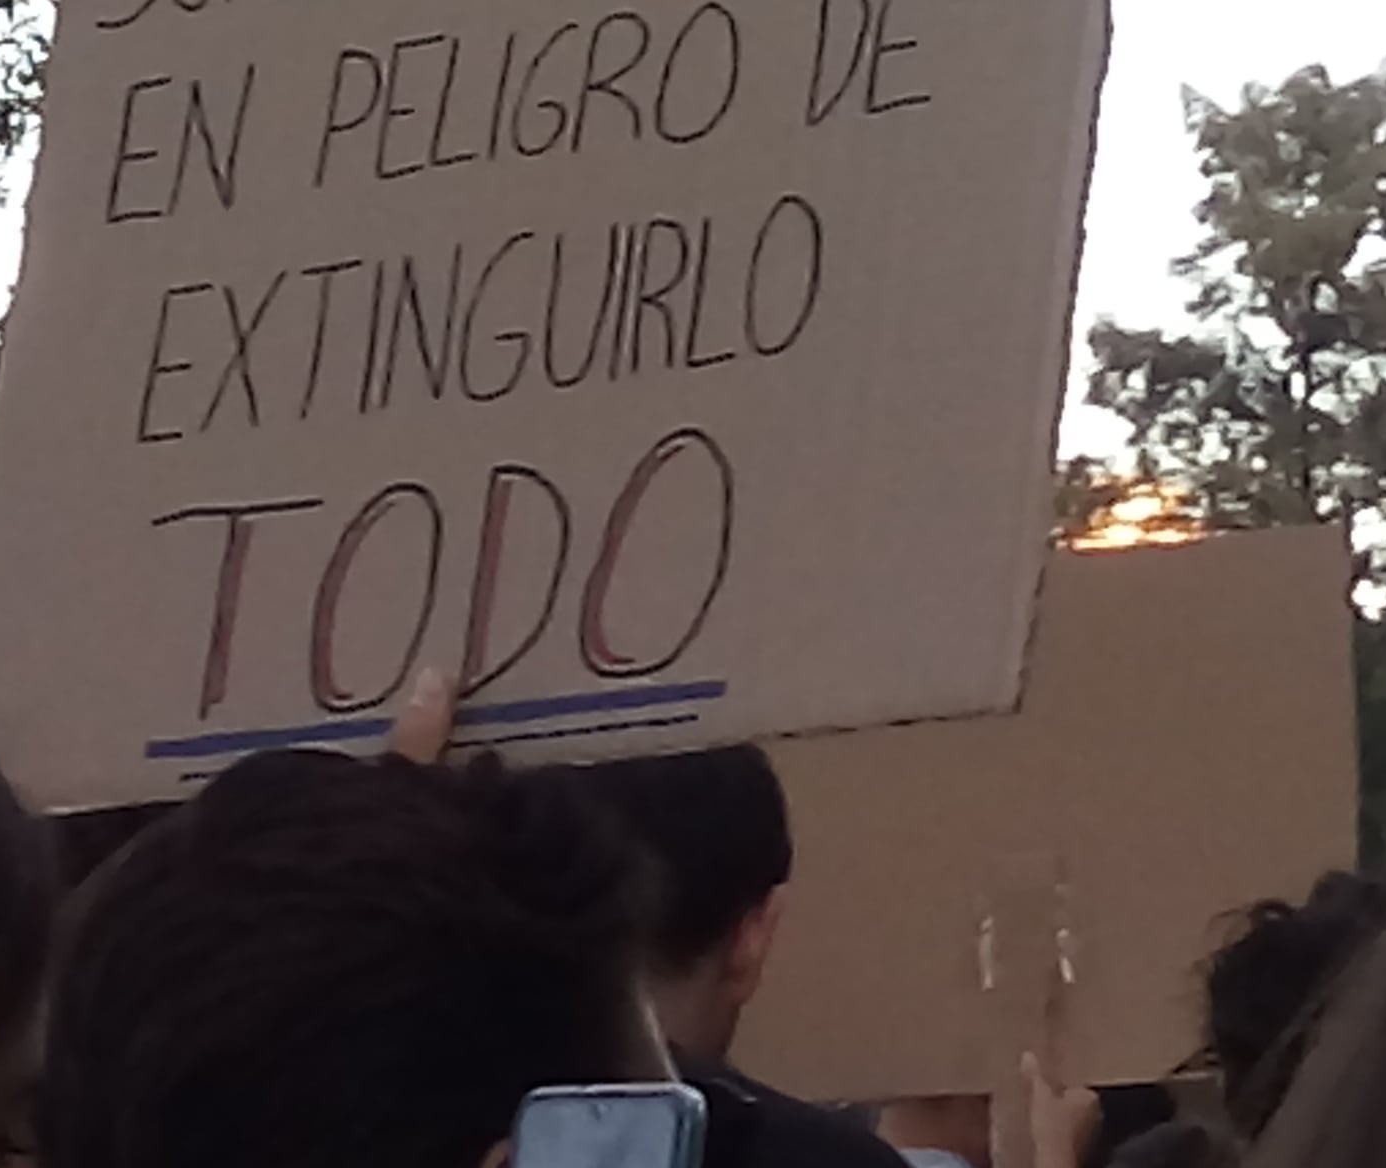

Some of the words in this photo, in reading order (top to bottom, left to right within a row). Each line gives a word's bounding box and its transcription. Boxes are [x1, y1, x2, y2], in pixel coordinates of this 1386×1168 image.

[106, 66, 256, 223] EN
[316, 1, 741, 189] PELIGRO
[136, 195, 823, 444] EXTINGUIRLO
[151, 428, 734, 721] TODO
